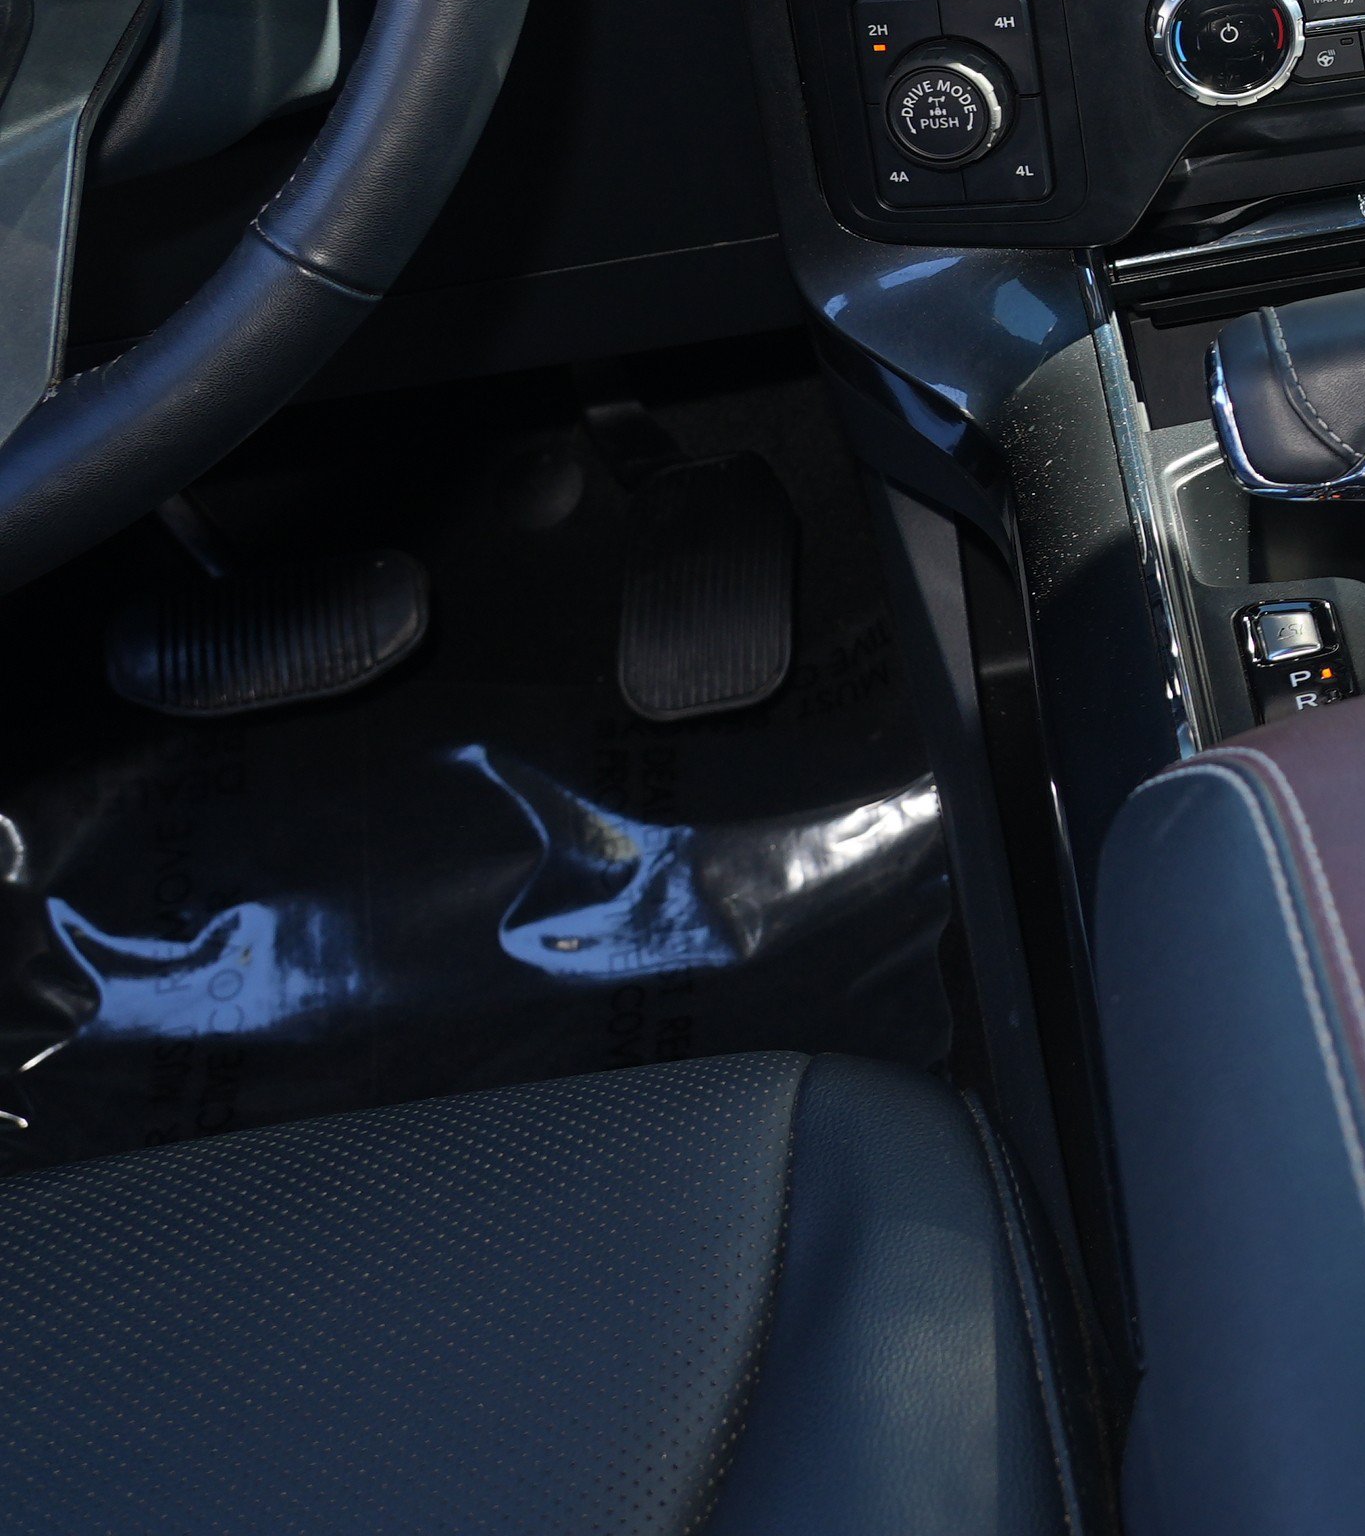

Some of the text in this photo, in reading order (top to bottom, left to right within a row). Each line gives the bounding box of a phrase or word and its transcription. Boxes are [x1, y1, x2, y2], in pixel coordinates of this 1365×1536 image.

[994, 16, 1015, 29] 4H
[867, 24, 888, 37] 2H
[901, 79, 977, 118] DRIVE MODE
[920, 116, 960, 130] PUSH
[889, 171, 909, 184] 4A
[1015, 164, 1034, 178] 4L
[1289, 669, 1312, 688] P
[1295, 692, 1319, 711] R
